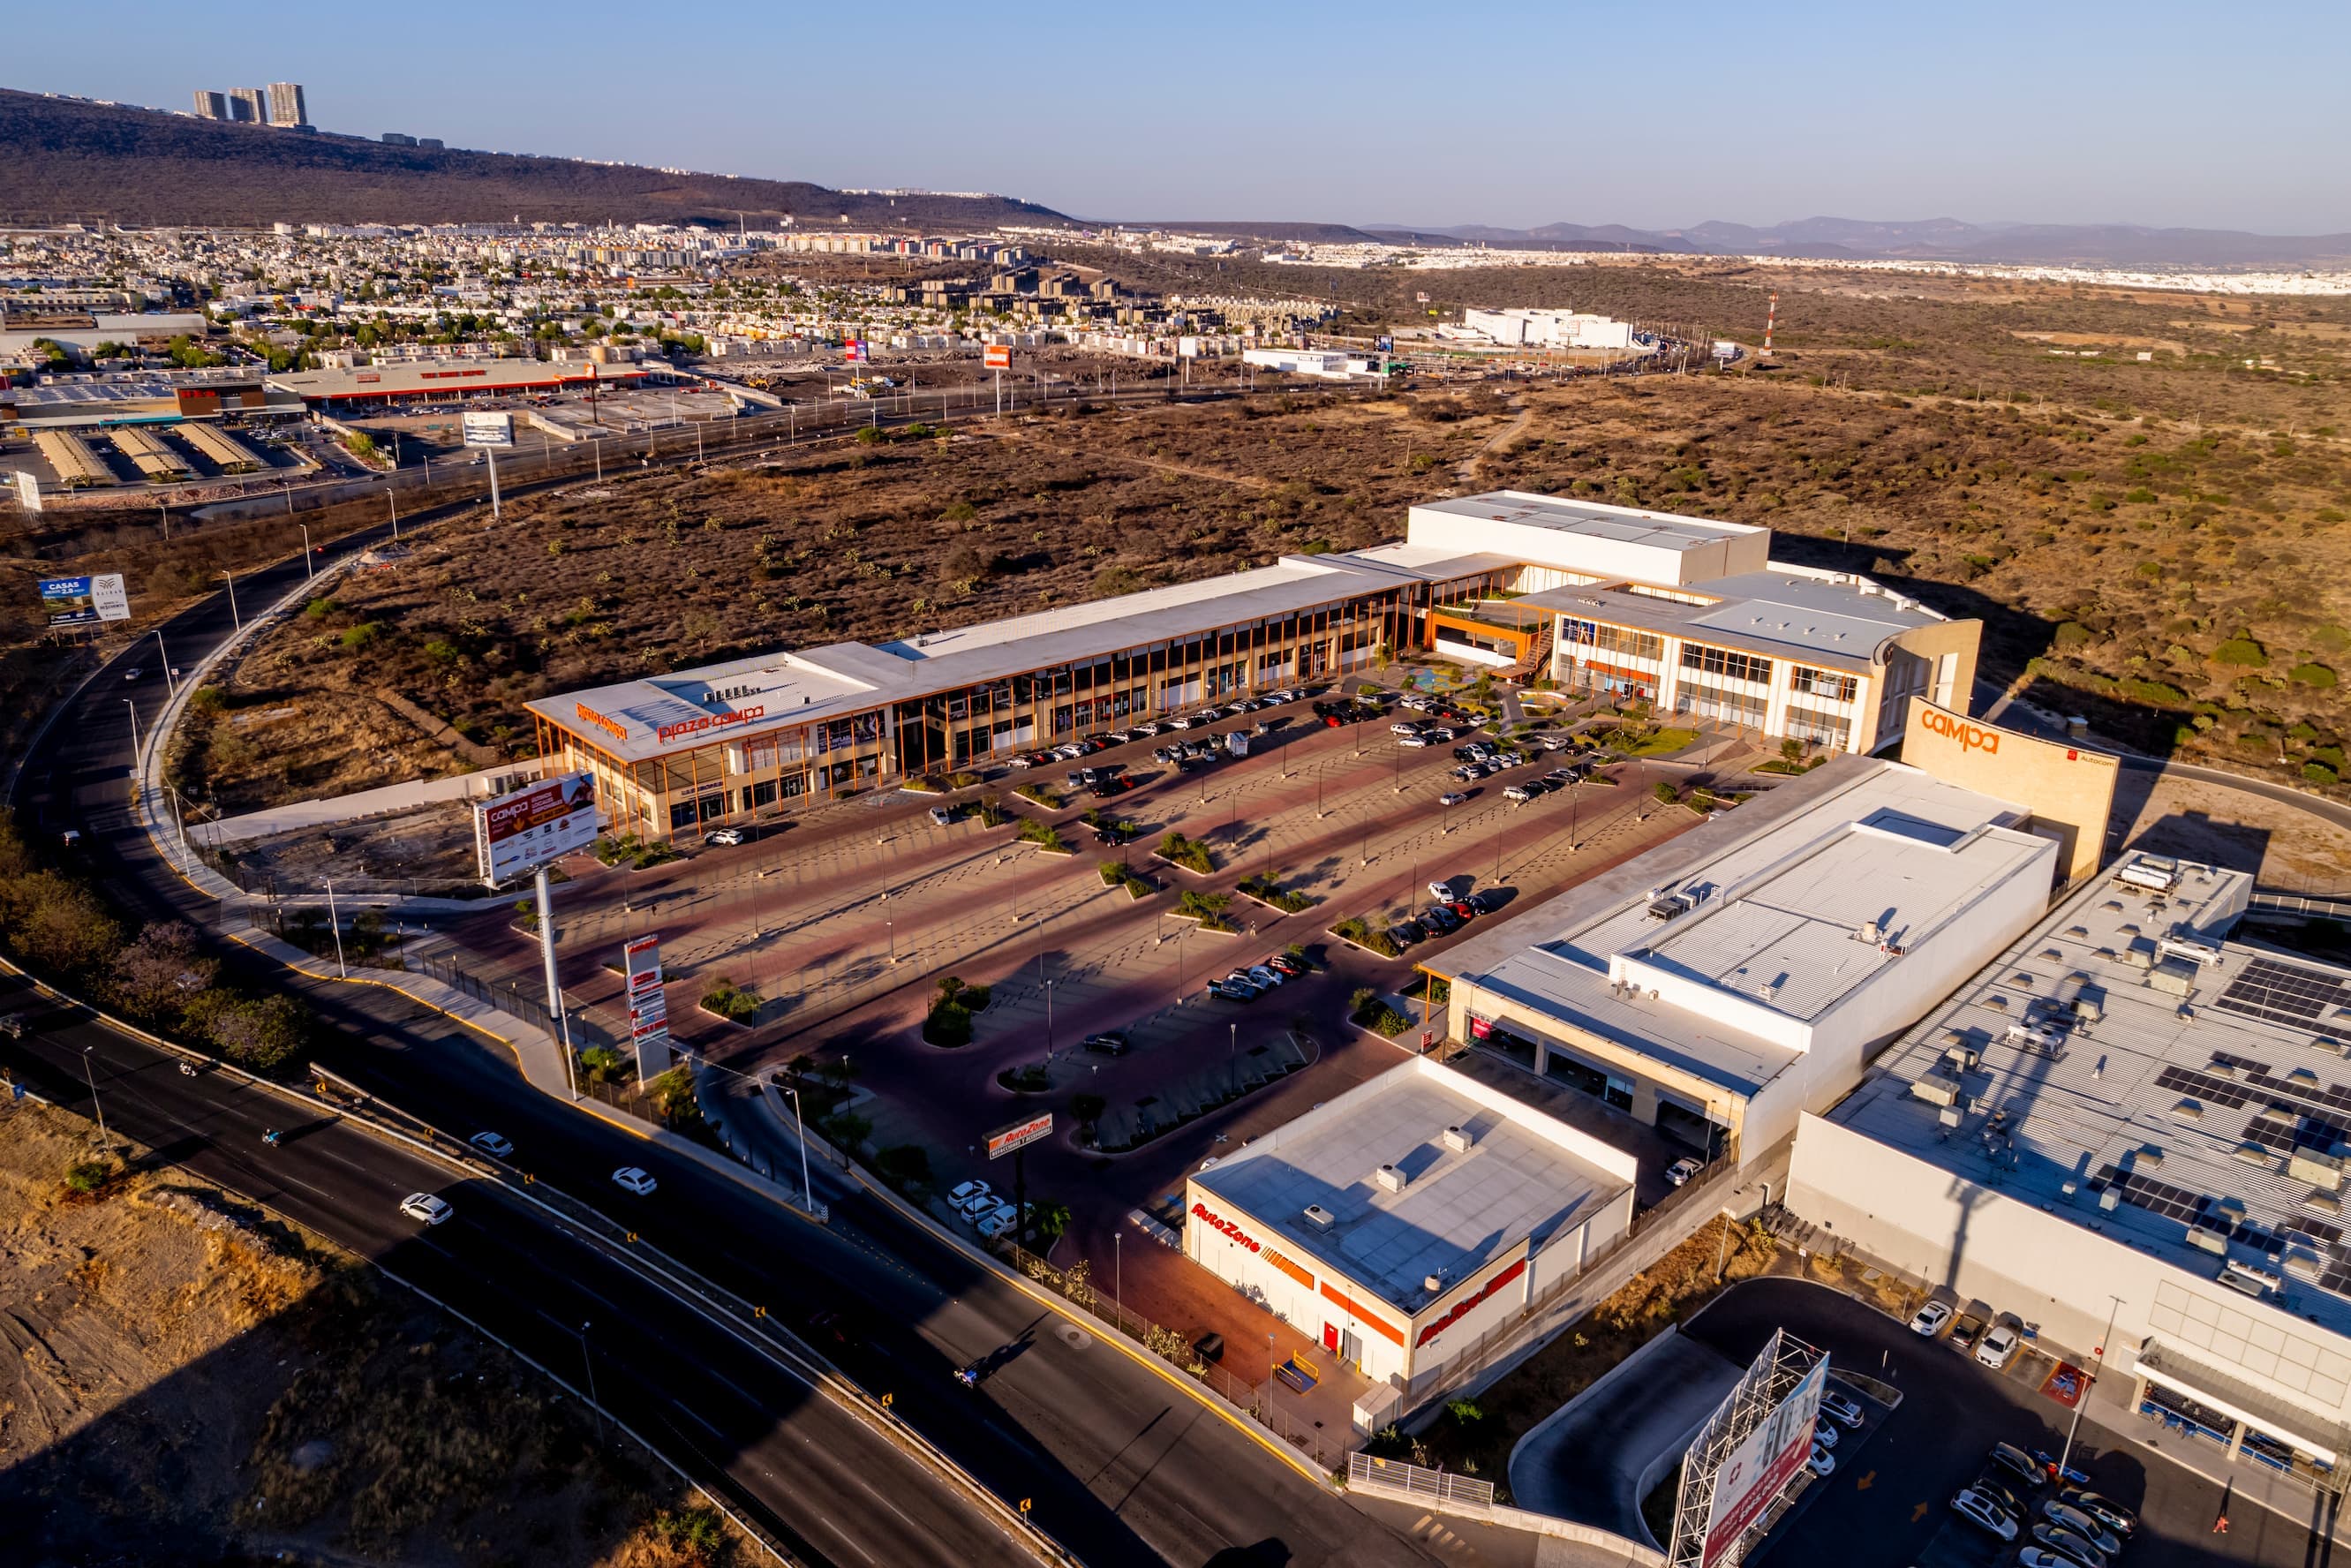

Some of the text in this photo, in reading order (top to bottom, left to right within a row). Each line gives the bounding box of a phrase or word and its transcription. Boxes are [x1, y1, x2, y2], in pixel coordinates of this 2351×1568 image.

[657, 705, 765, 744] plaza campa
[1921, 708, 2001, 755] campa
[2080, 754, 2115, 767] Autocom
[490, 801, 529, 823] campa
[1004, 1118, 1050, 1144] AutoZone
[1191, 1202, 1261, 1254] AutoZone
